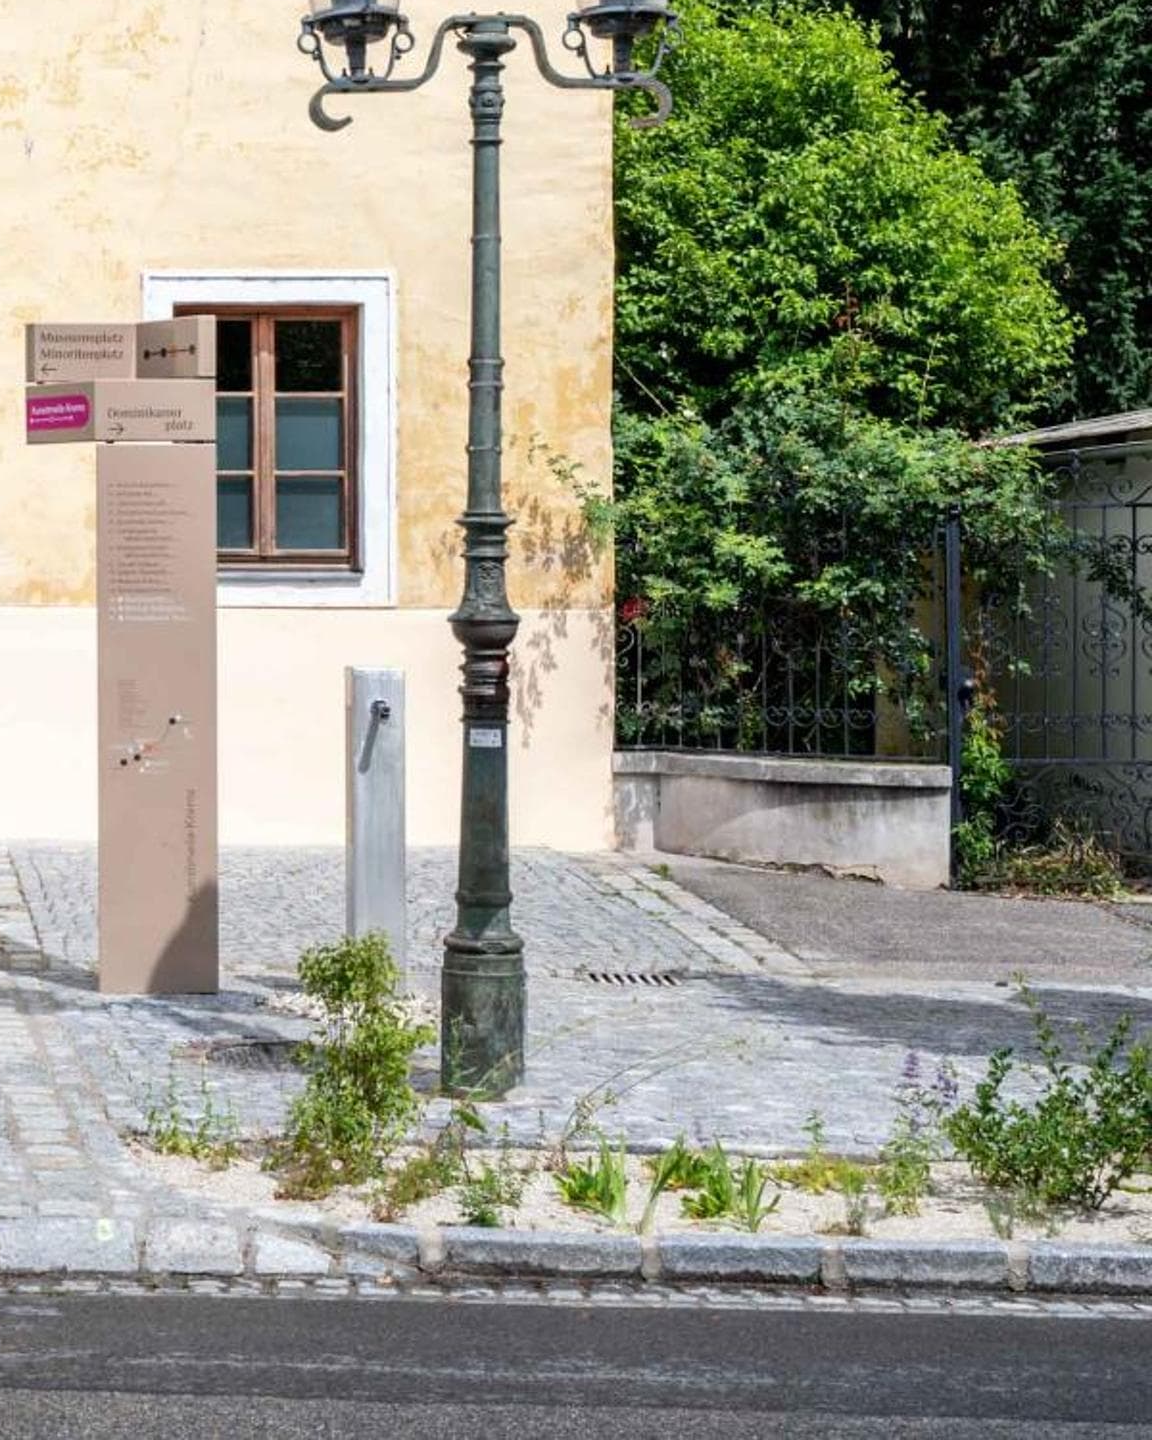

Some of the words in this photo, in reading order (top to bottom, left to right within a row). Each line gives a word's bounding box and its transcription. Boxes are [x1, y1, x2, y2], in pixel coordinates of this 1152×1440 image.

[41, 330, 124, 344] Museumsplatz
[41, 348, 124, 360] Minoritenplatz
[165, 420, 193, 432] platz
